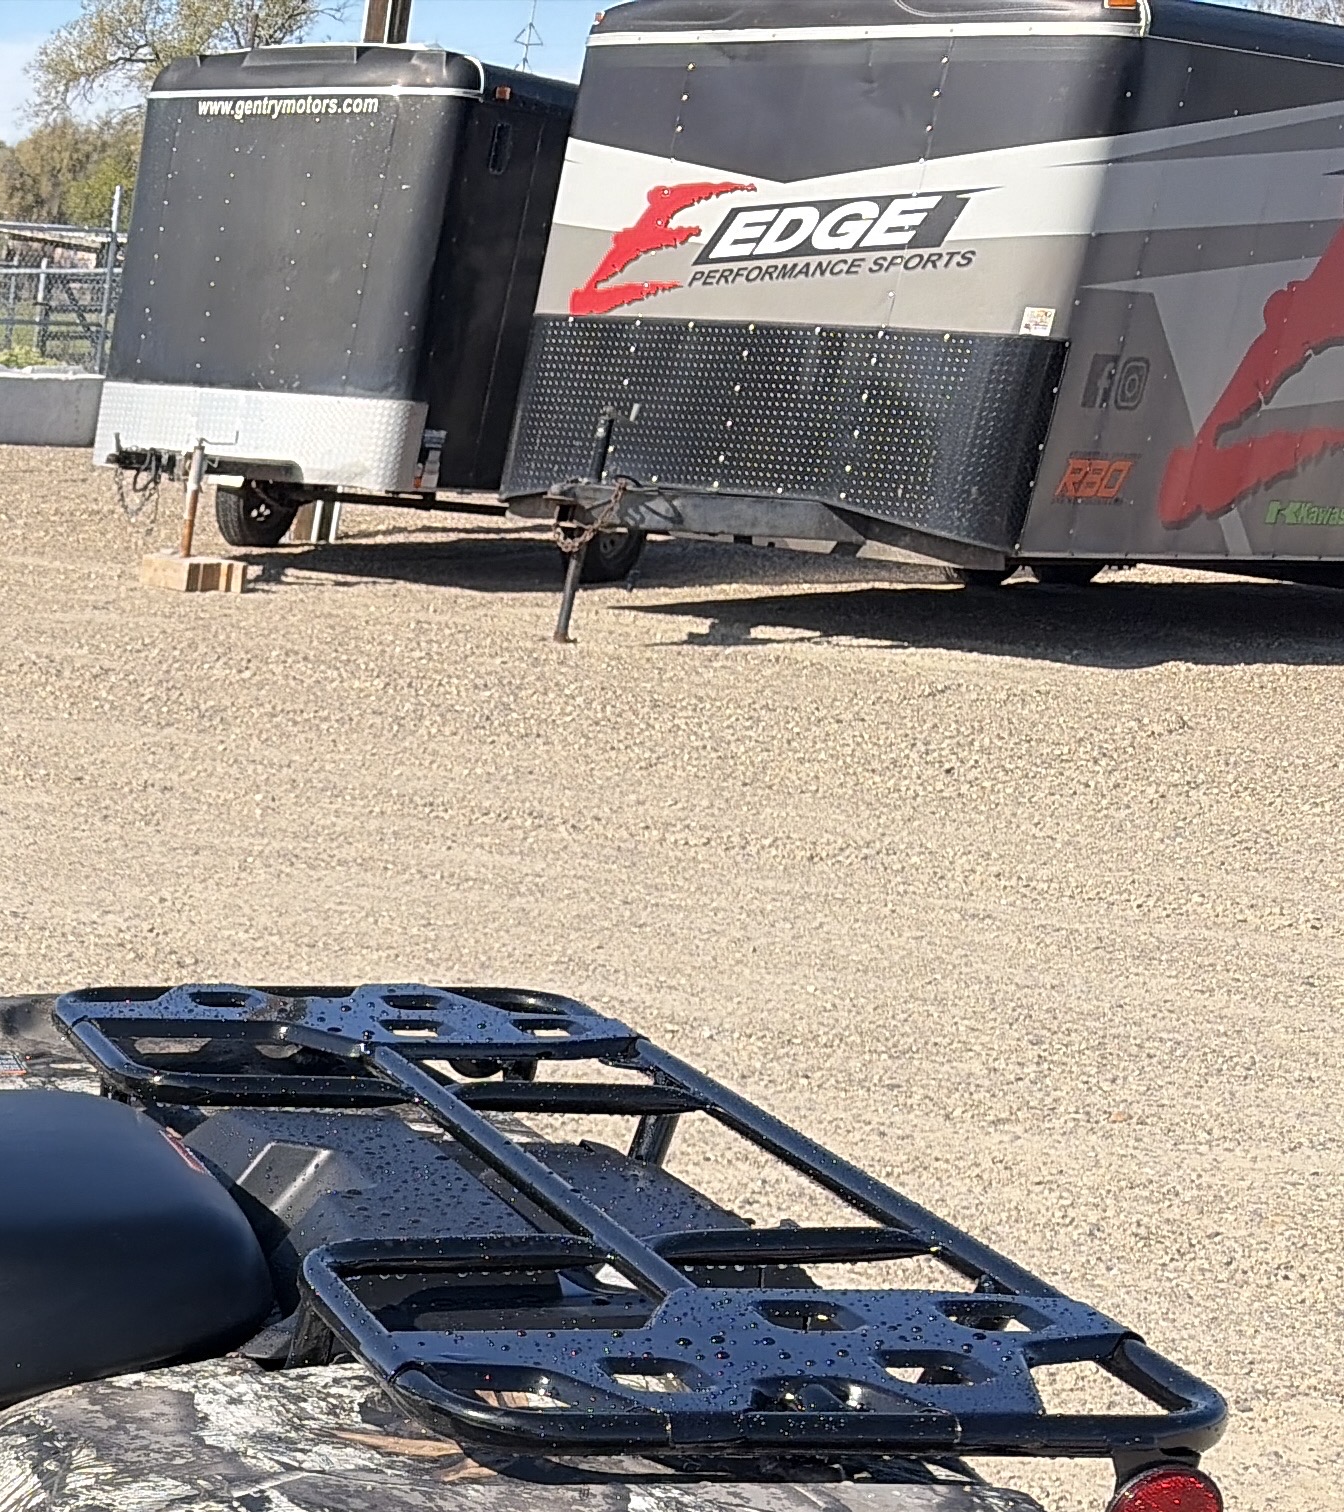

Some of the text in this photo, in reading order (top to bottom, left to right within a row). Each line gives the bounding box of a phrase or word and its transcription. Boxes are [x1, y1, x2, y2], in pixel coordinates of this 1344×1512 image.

[198, 96, 379, 120] www.gentrymotors.com
[708, 196, 944, 259] EDGE
[688, 250, 977, 288] PERFORMANCE SPORTS
